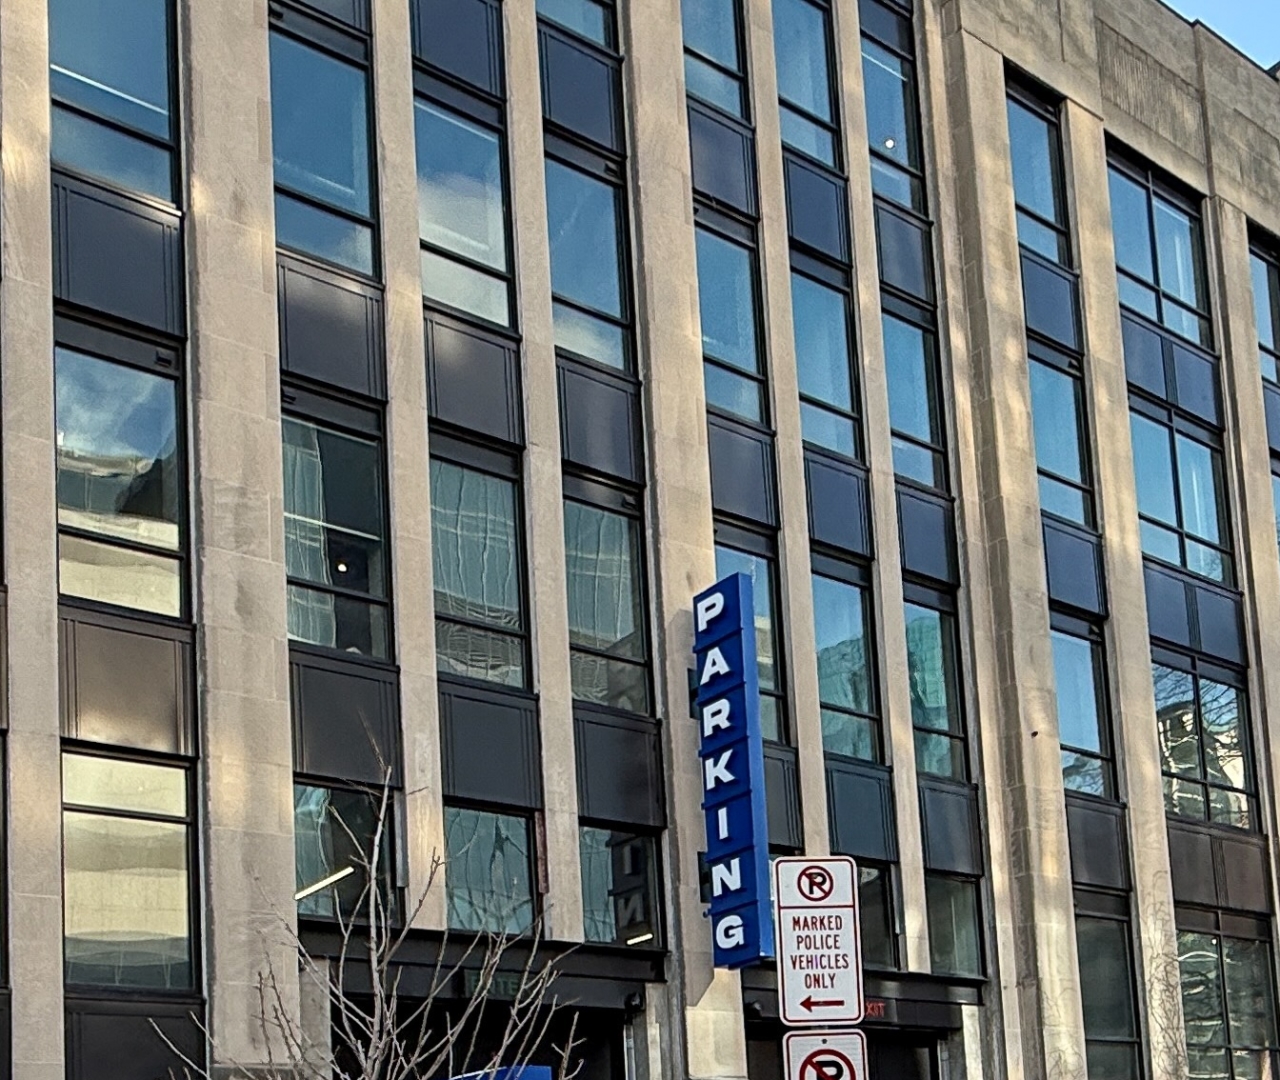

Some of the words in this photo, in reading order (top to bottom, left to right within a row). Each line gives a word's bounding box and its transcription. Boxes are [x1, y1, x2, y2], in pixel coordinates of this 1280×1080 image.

[696, 591, 746, 950] PARKING
[792, 915, 843, 931] MARKED
[796, 933, 841, 950] POLICE
[790, 953, 850, 970] VEHICLES
[804, 972, 837, 990] ONLY
[866, 1002, 886, 1019] XIT
